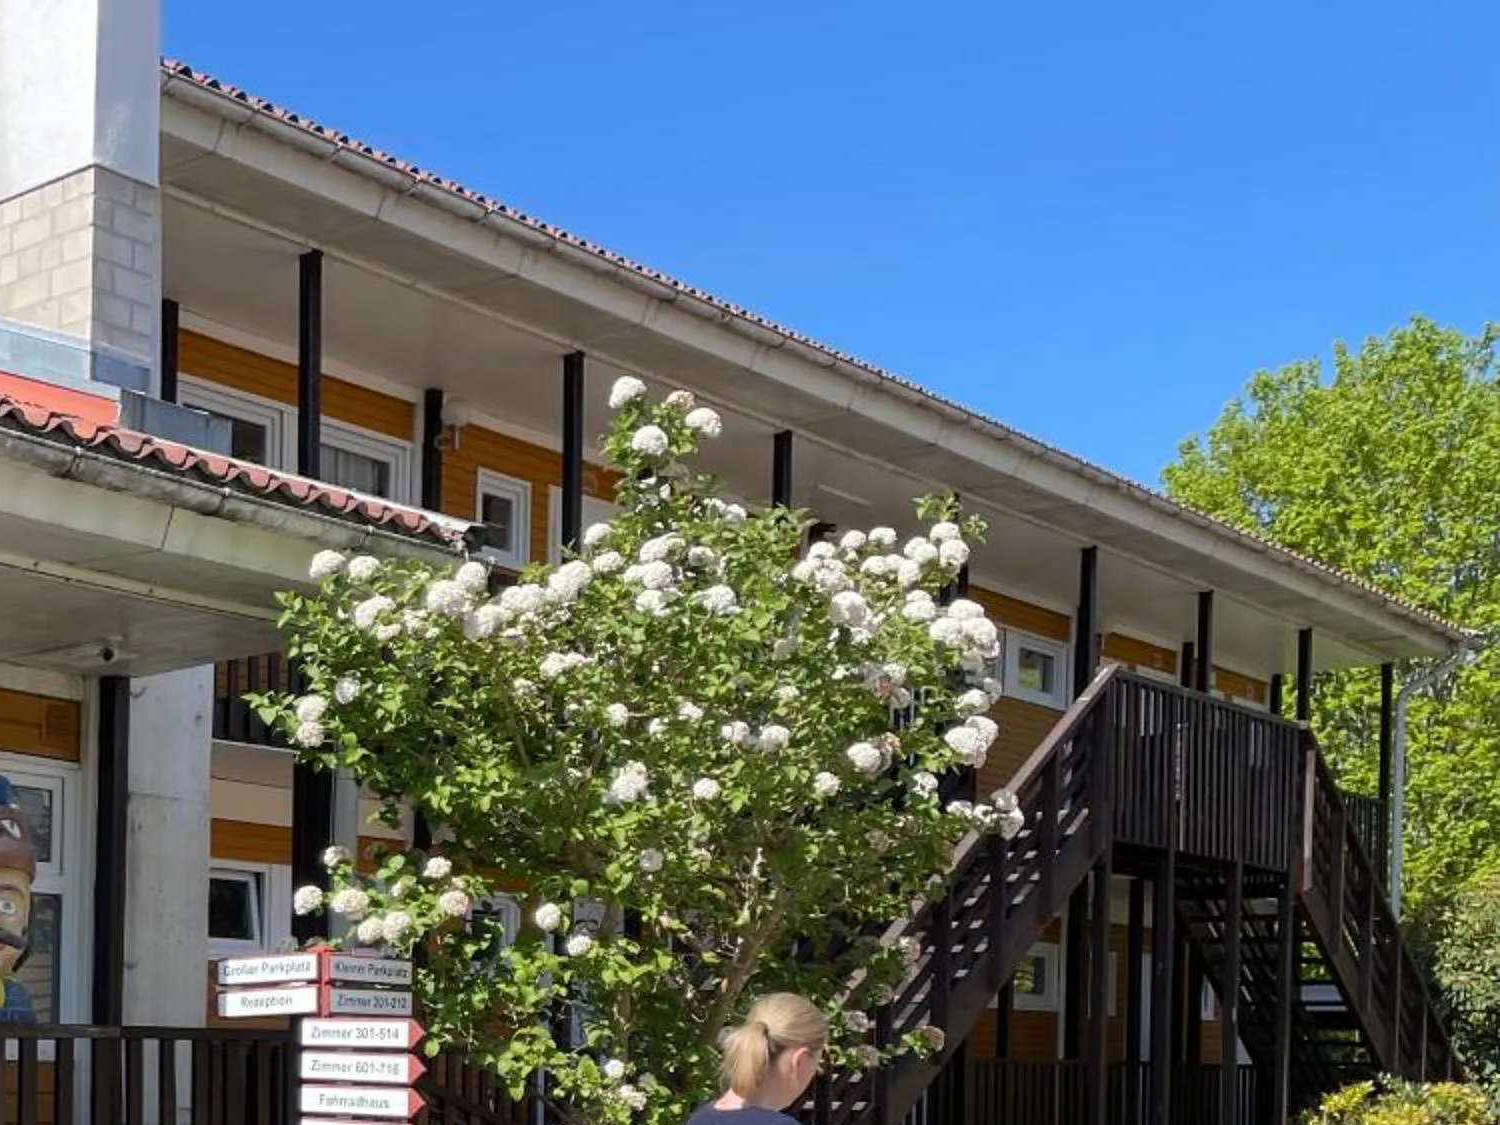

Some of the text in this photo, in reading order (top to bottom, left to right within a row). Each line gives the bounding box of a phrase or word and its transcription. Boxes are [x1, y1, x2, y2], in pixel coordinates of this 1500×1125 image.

[261, 960, 311, 977] Parkplatz
[368, 963, 408, 979] Parkplatz
[240, 995, 293, 1009] Rezeption
[337, 995, 371, 1008] Zimmer
[310, 1025, 353, 1040] Zimmer
[310, 1059, 353, 1073] Zimmer
[318, 1093, 391, 1109] Fahrradhaus
